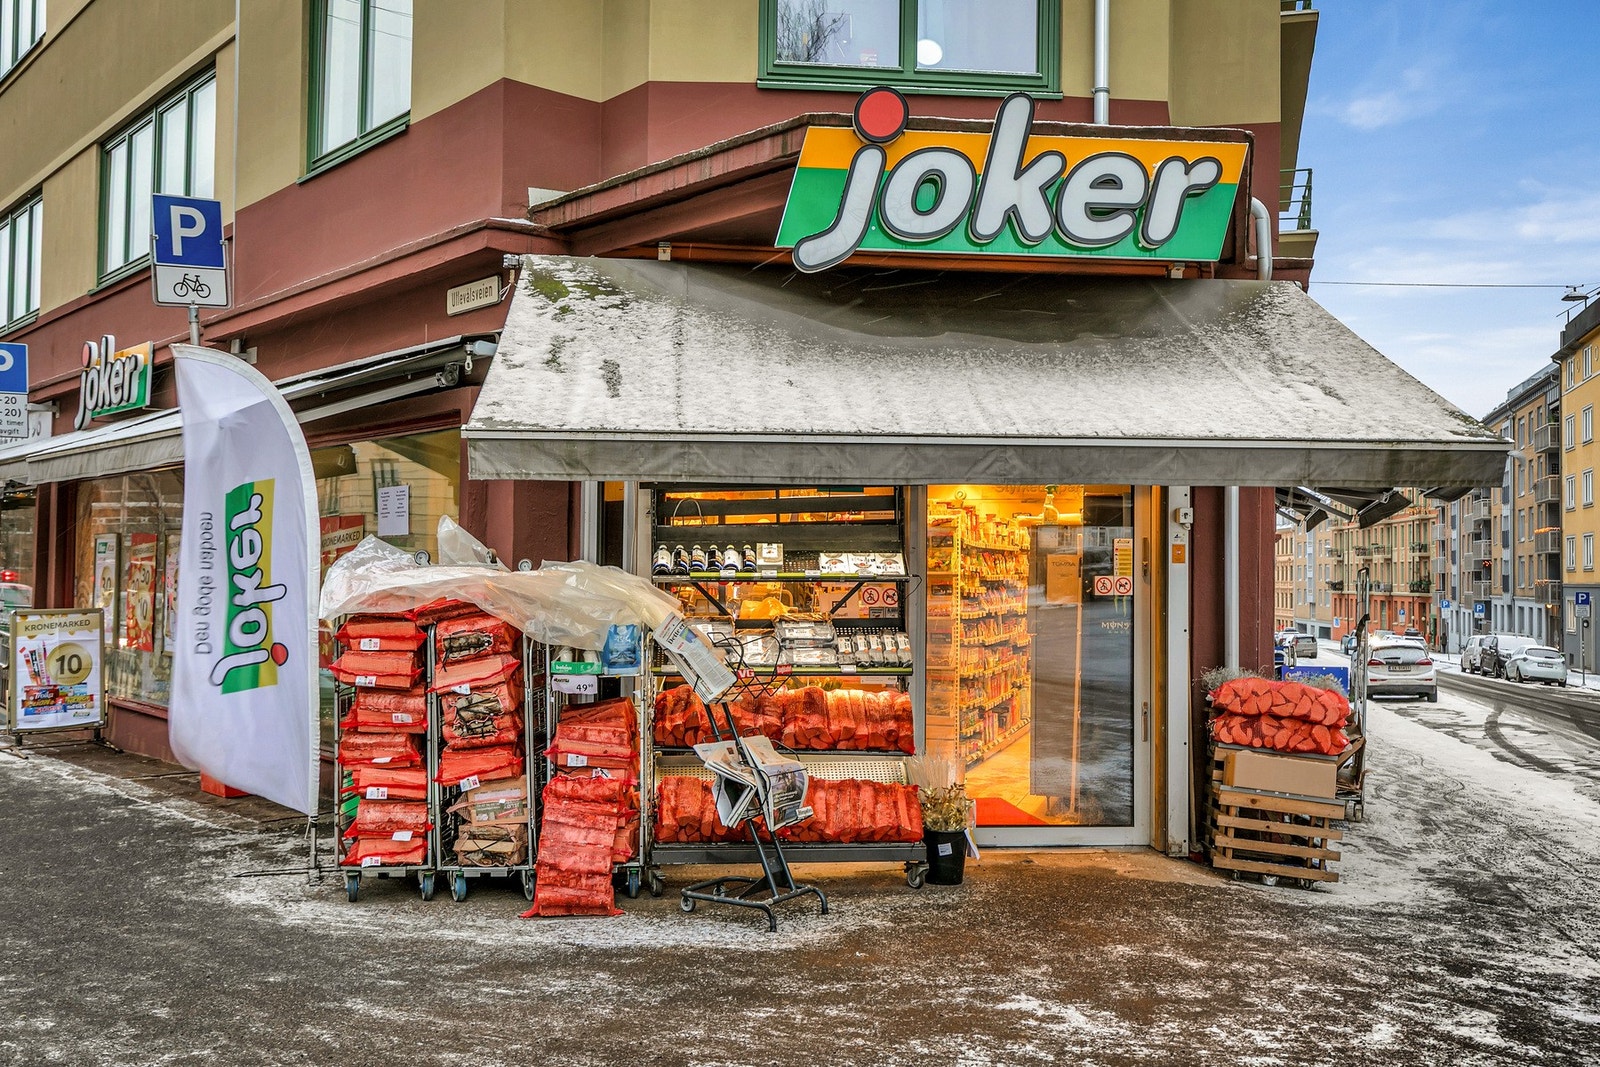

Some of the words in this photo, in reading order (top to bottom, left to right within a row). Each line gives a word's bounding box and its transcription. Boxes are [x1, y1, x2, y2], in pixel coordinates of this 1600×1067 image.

[793, 86, 1222, 273] joker
[169, 205, 206, 257] P
[451, 283, 493, 308] Ullevålsveien
[74, 334, 144, 431] joker
[6, 419, 24, 427] timer
[1579, 593, 1587, 603] P
[1442, 600, 1449, 609] P
[1476, 604, 1483, 613] P
[25, 619, 91, 632] KRONEMARKED
[56, 653, 83, 675] 10
[739, 669, 754, 678] VG
[576, 683, 588, 692] 49
